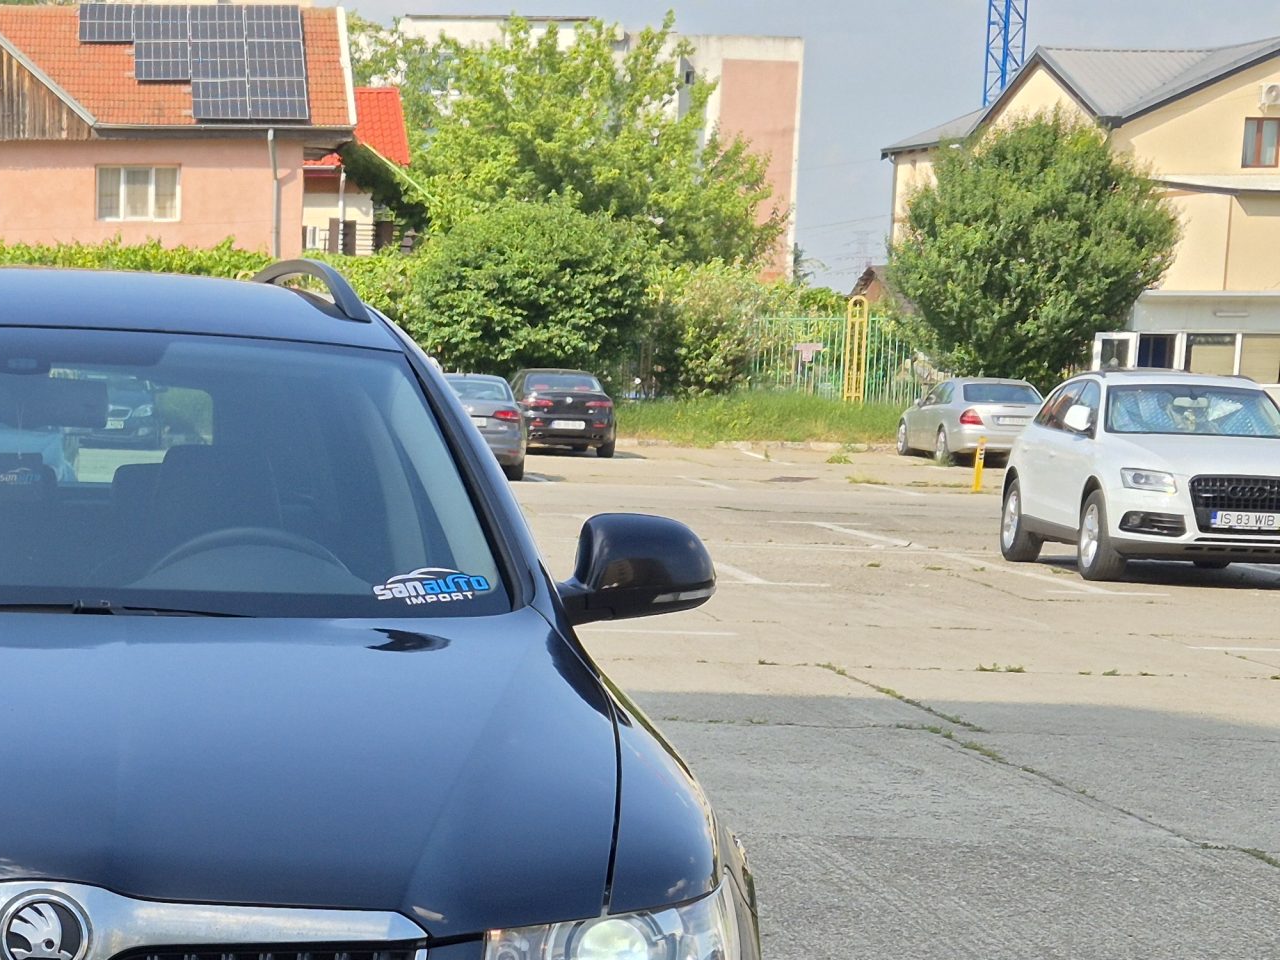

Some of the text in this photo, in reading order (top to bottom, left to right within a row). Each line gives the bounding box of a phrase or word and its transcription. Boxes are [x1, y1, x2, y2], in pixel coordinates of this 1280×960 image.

[1221, 512, 1275, 526] IS 83 WIB
[405, 591, 473, 605] IMPORT
